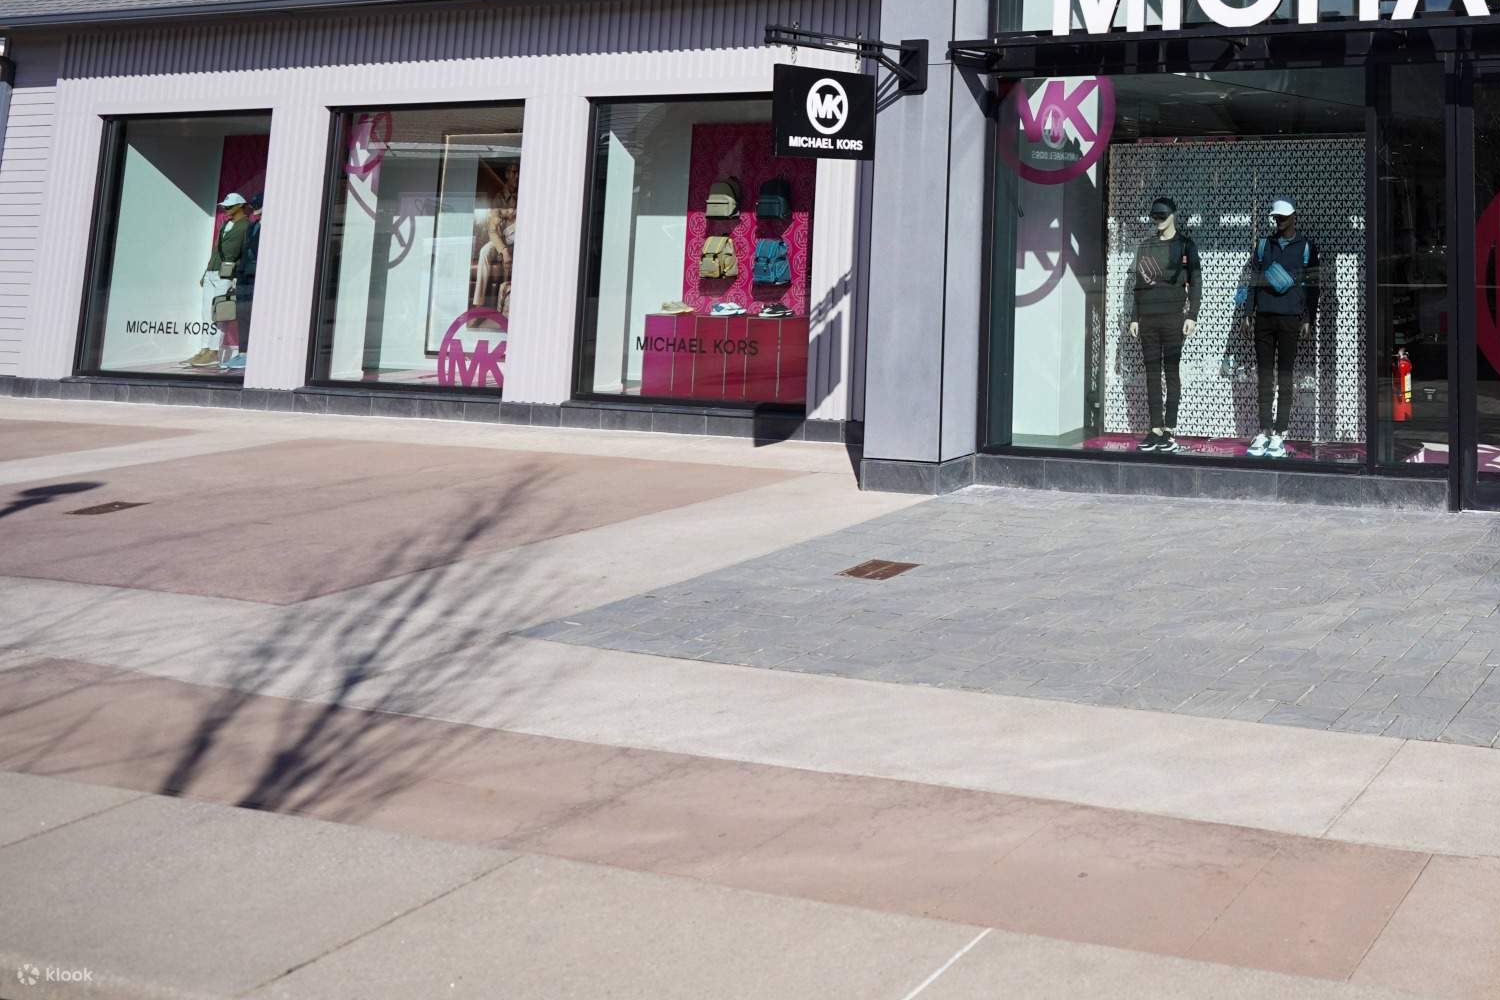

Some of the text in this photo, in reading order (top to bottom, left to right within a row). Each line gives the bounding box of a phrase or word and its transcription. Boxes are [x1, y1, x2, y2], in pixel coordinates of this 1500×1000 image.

[788, 135, 864, 151] MICHAEL KORS
[126, 320, 218, 336] MICHAEL KORS
[636, 335, 759, 356] MICHAEL KORS
